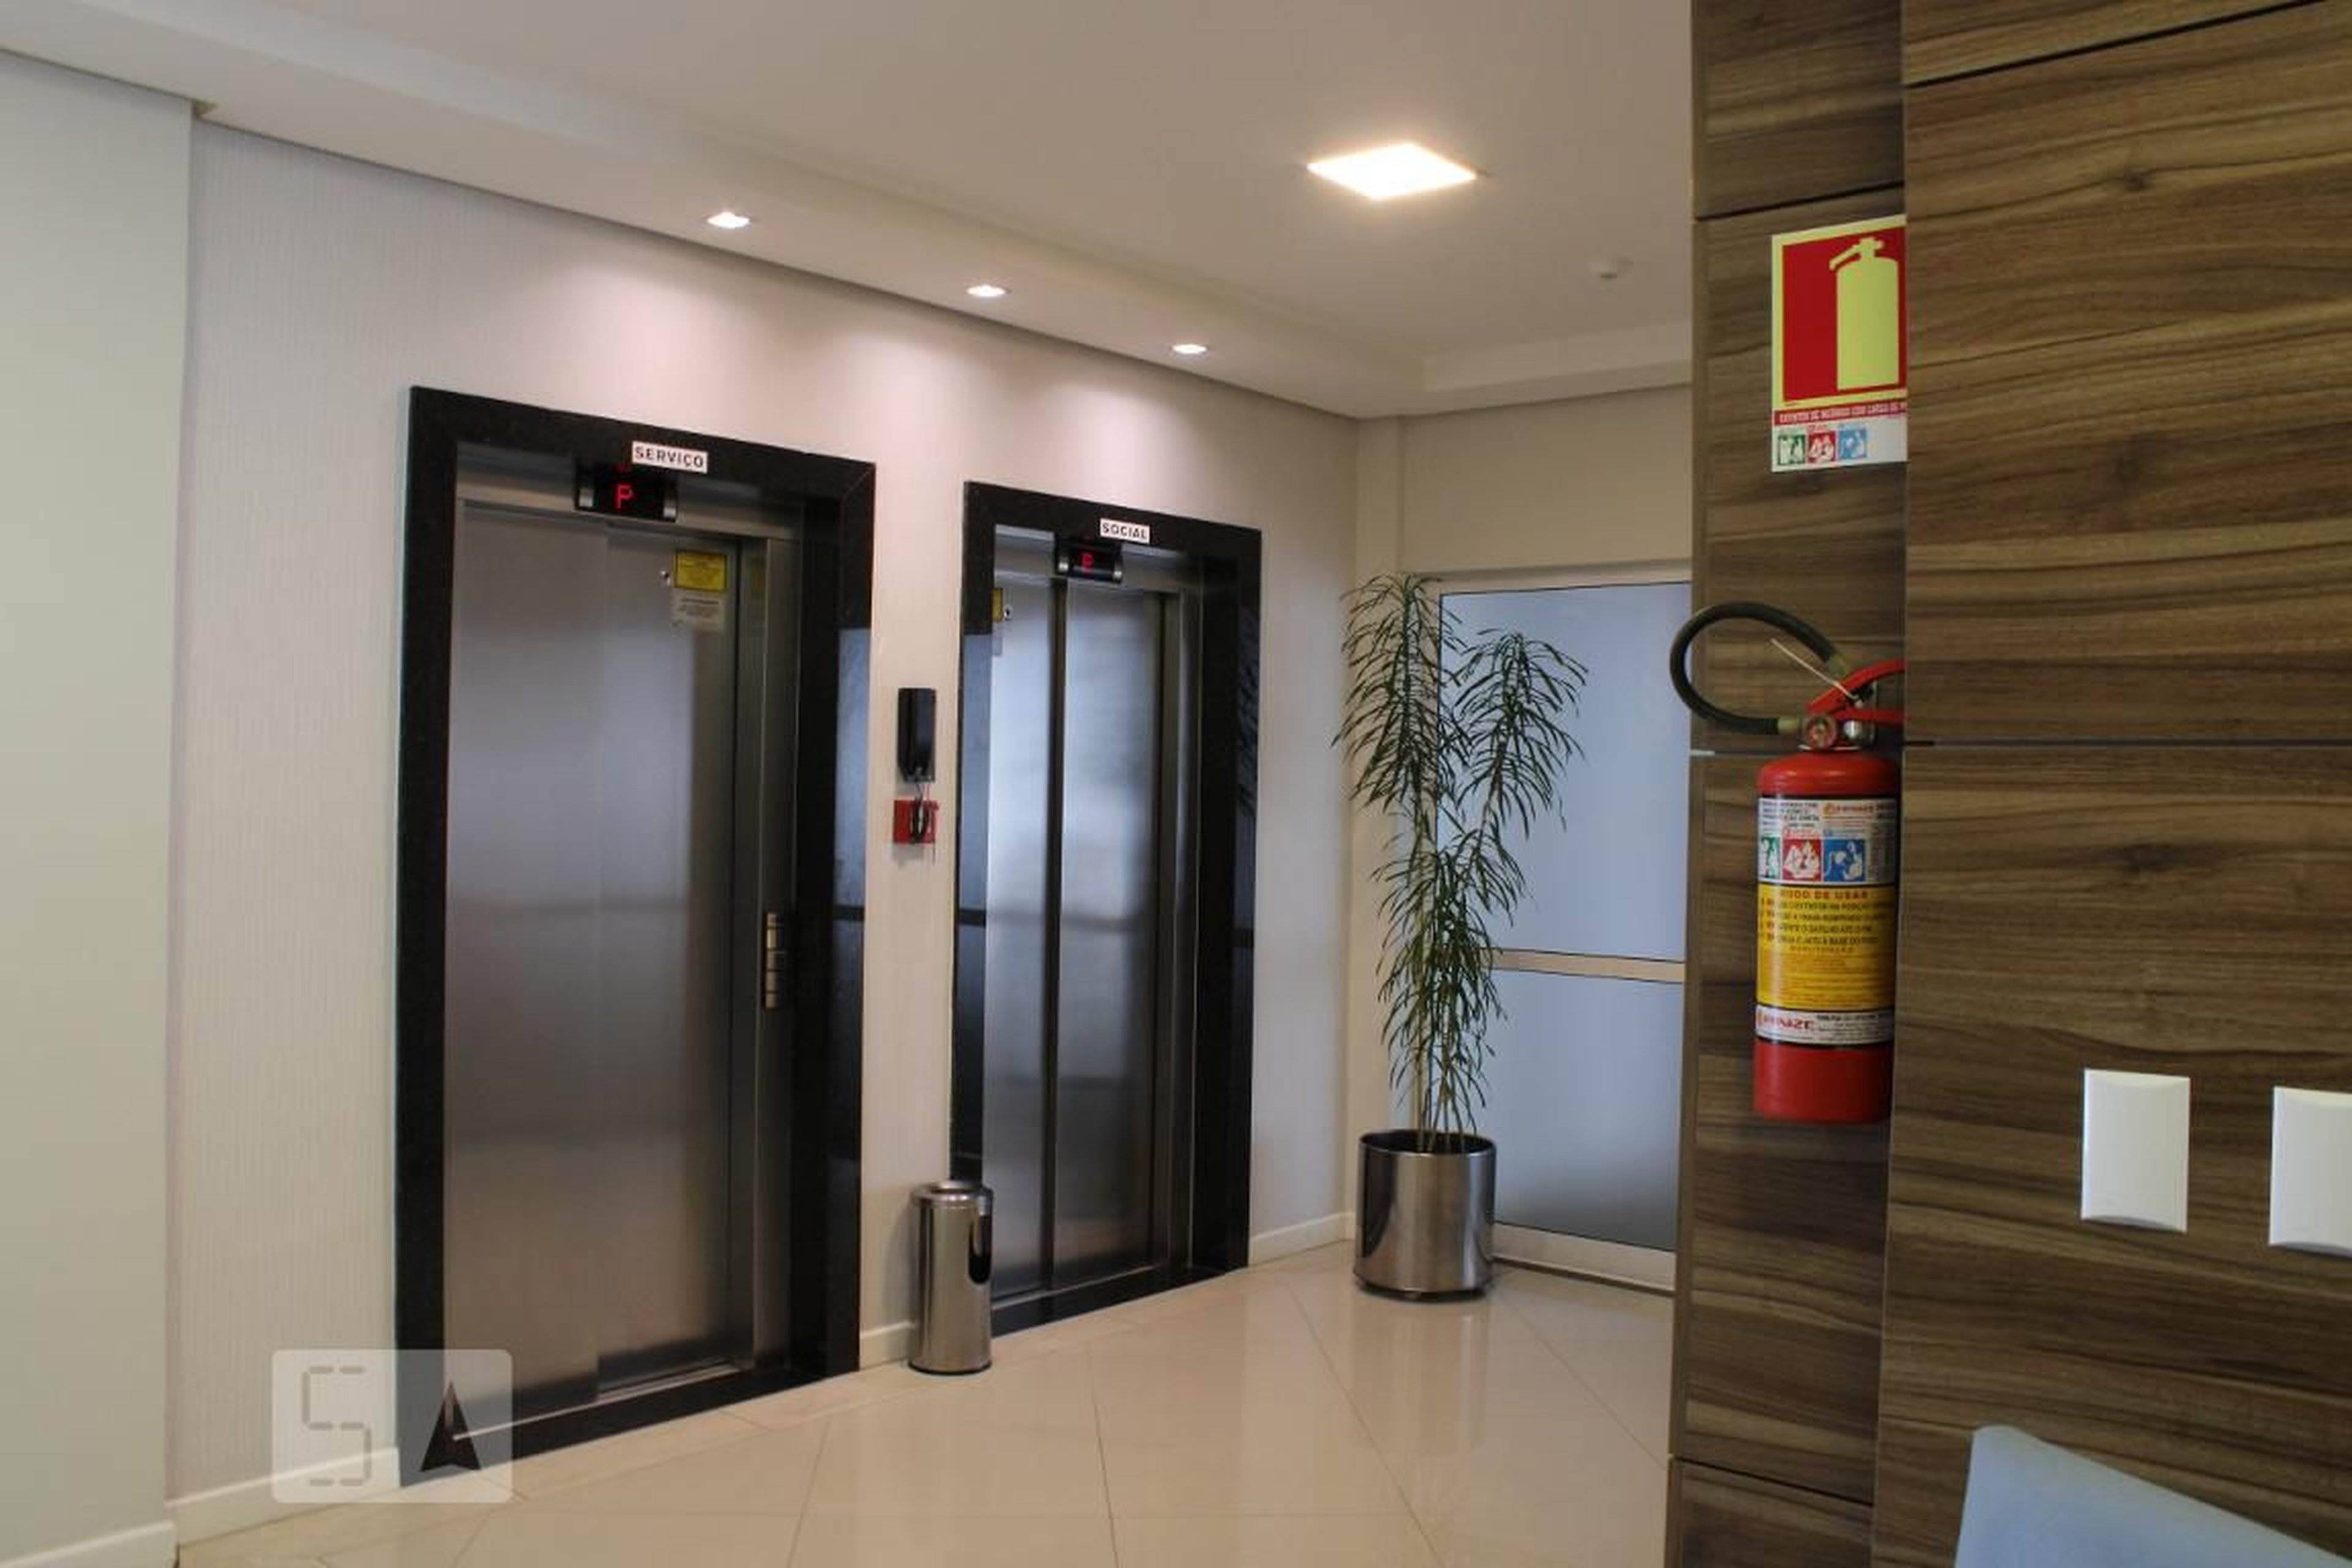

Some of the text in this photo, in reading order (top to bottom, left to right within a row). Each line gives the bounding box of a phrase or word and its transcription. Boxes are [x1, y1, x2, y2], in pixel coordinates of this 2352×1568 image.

[635, 446, 704, 468] SERVIÇO
[615, 484, 633, 509] P
[1102, 522, 1148, 540] SOCIAL
